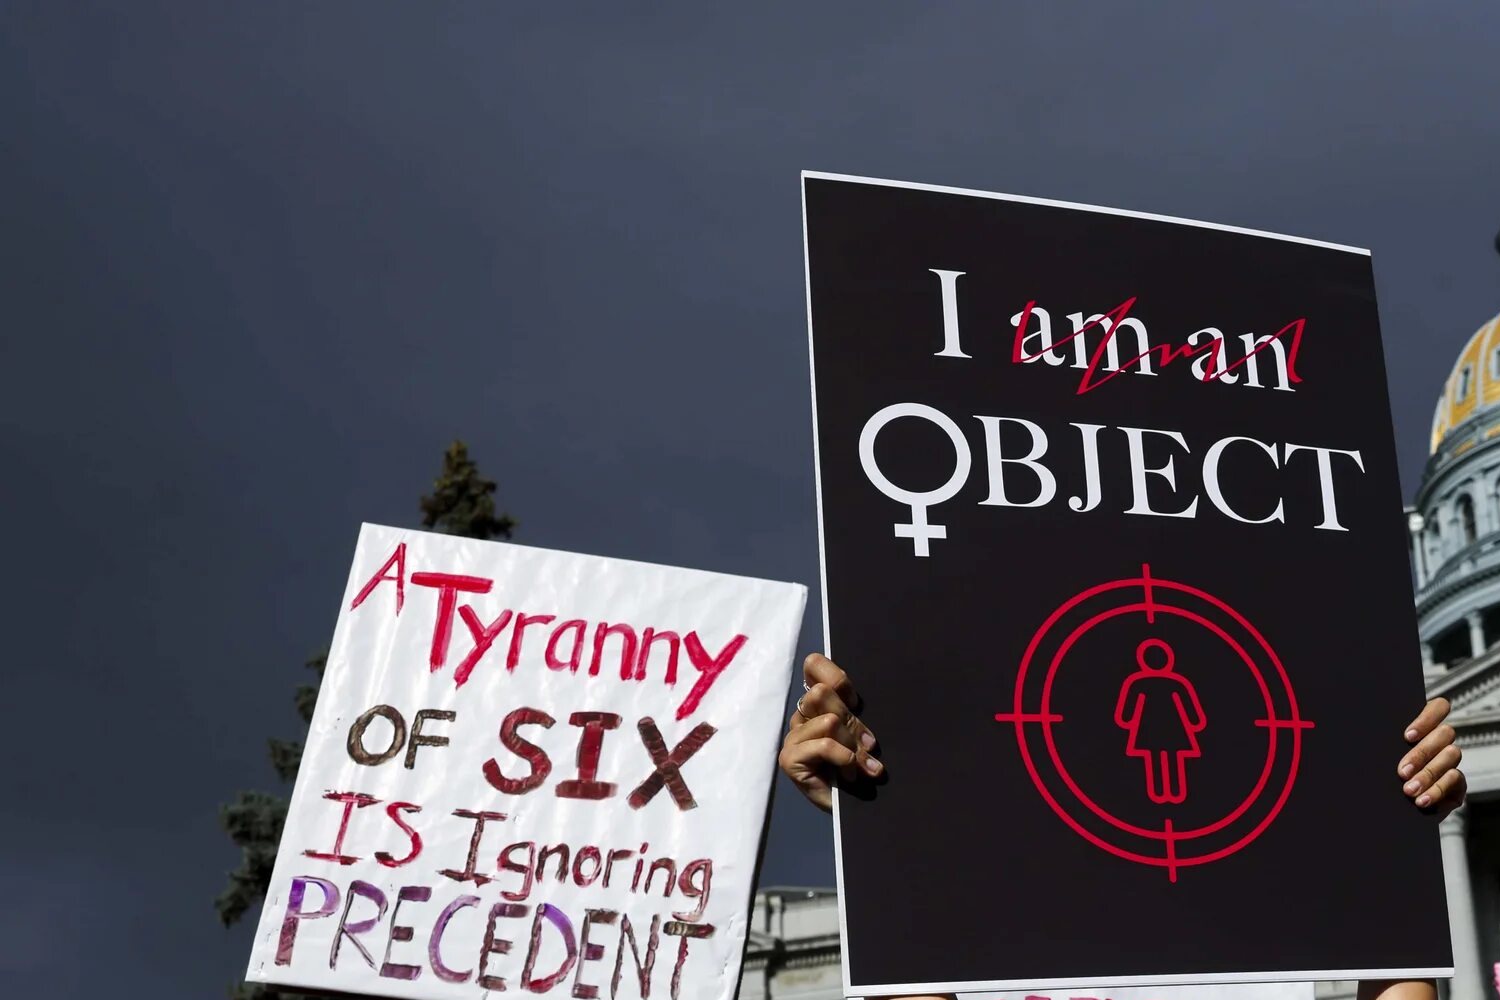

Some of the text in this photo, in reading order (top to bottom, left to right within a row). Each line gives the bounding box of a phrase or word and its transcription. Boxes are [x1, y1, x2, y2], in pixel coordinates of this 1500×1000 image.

[928, 267, 1296, 392] I am an
[859, 402, 1366, 557] OBJECT
[350, 542, 748, 721] A Tyranny
[347, 704, 718, 812] OF SIX
[301, 791, 713, 922] IS Ignoring
